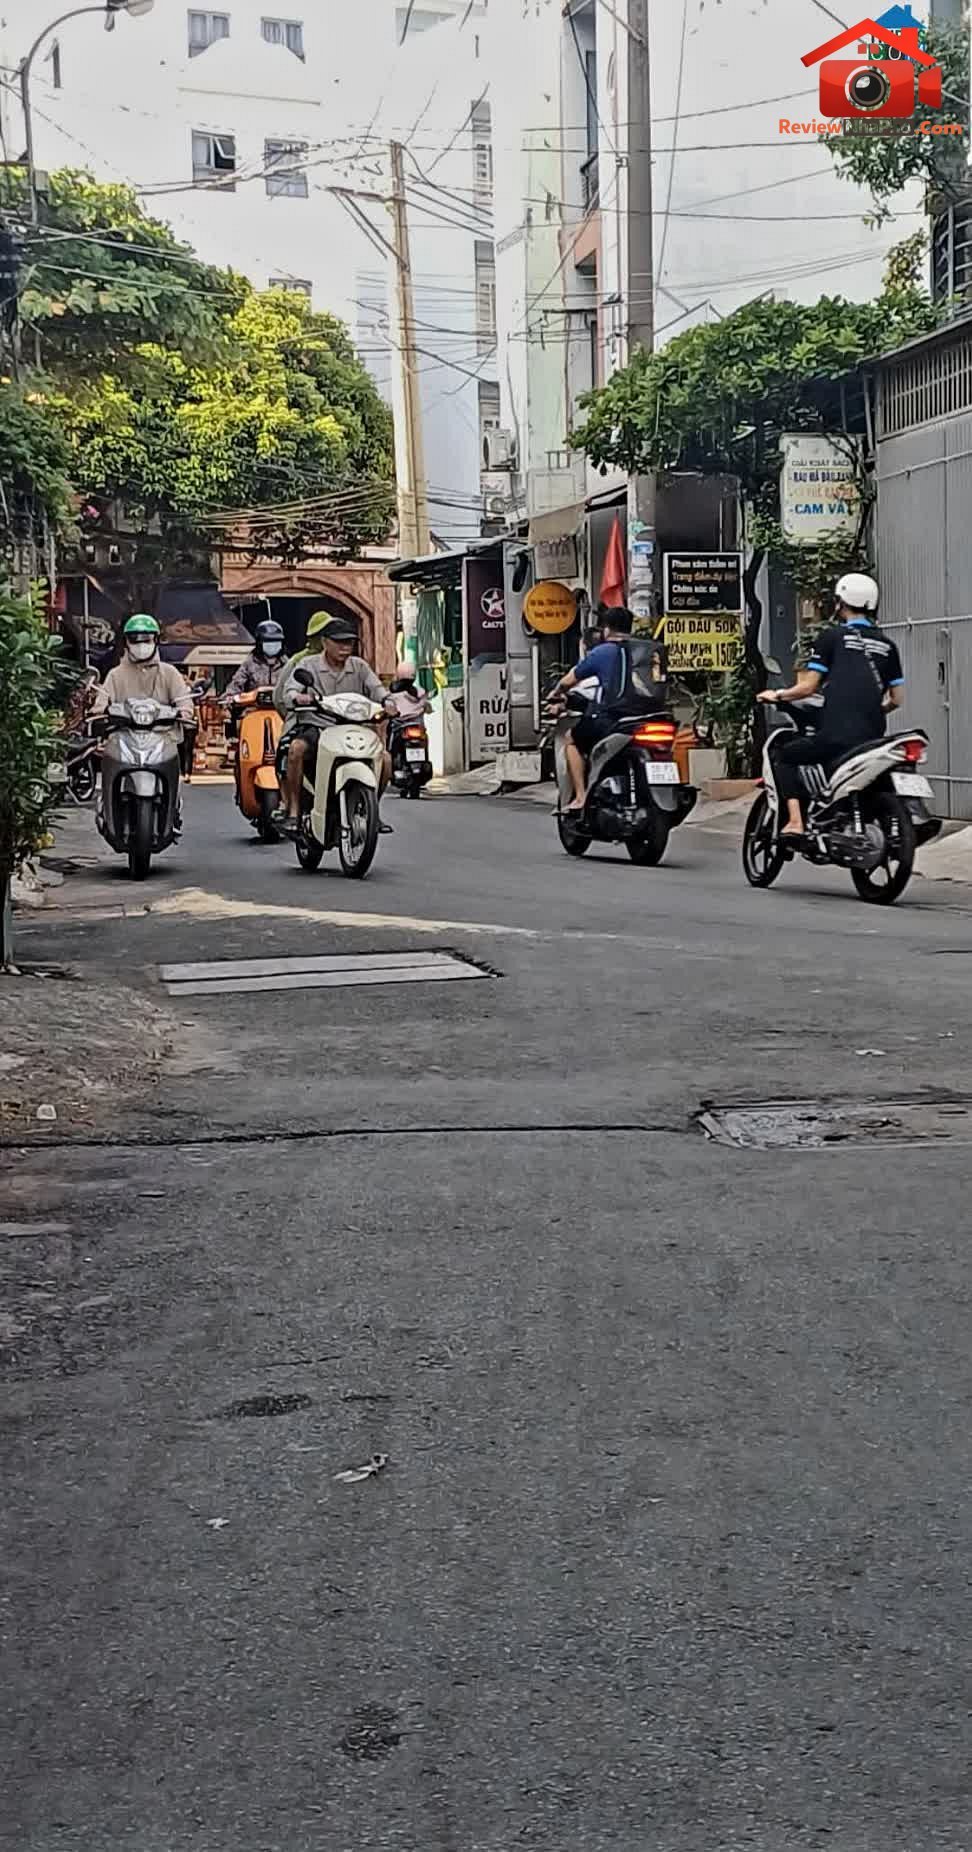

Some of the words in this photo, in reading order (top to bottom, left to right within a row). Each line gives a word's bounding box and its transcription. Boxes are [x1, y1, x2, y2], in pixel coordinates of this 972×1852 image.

[795, 504, 823, 513] CAM
[715, 620, 738, 633] 50K
[716, 642, 738, 667] 150
[485, 722, 507, 737] BƠ
